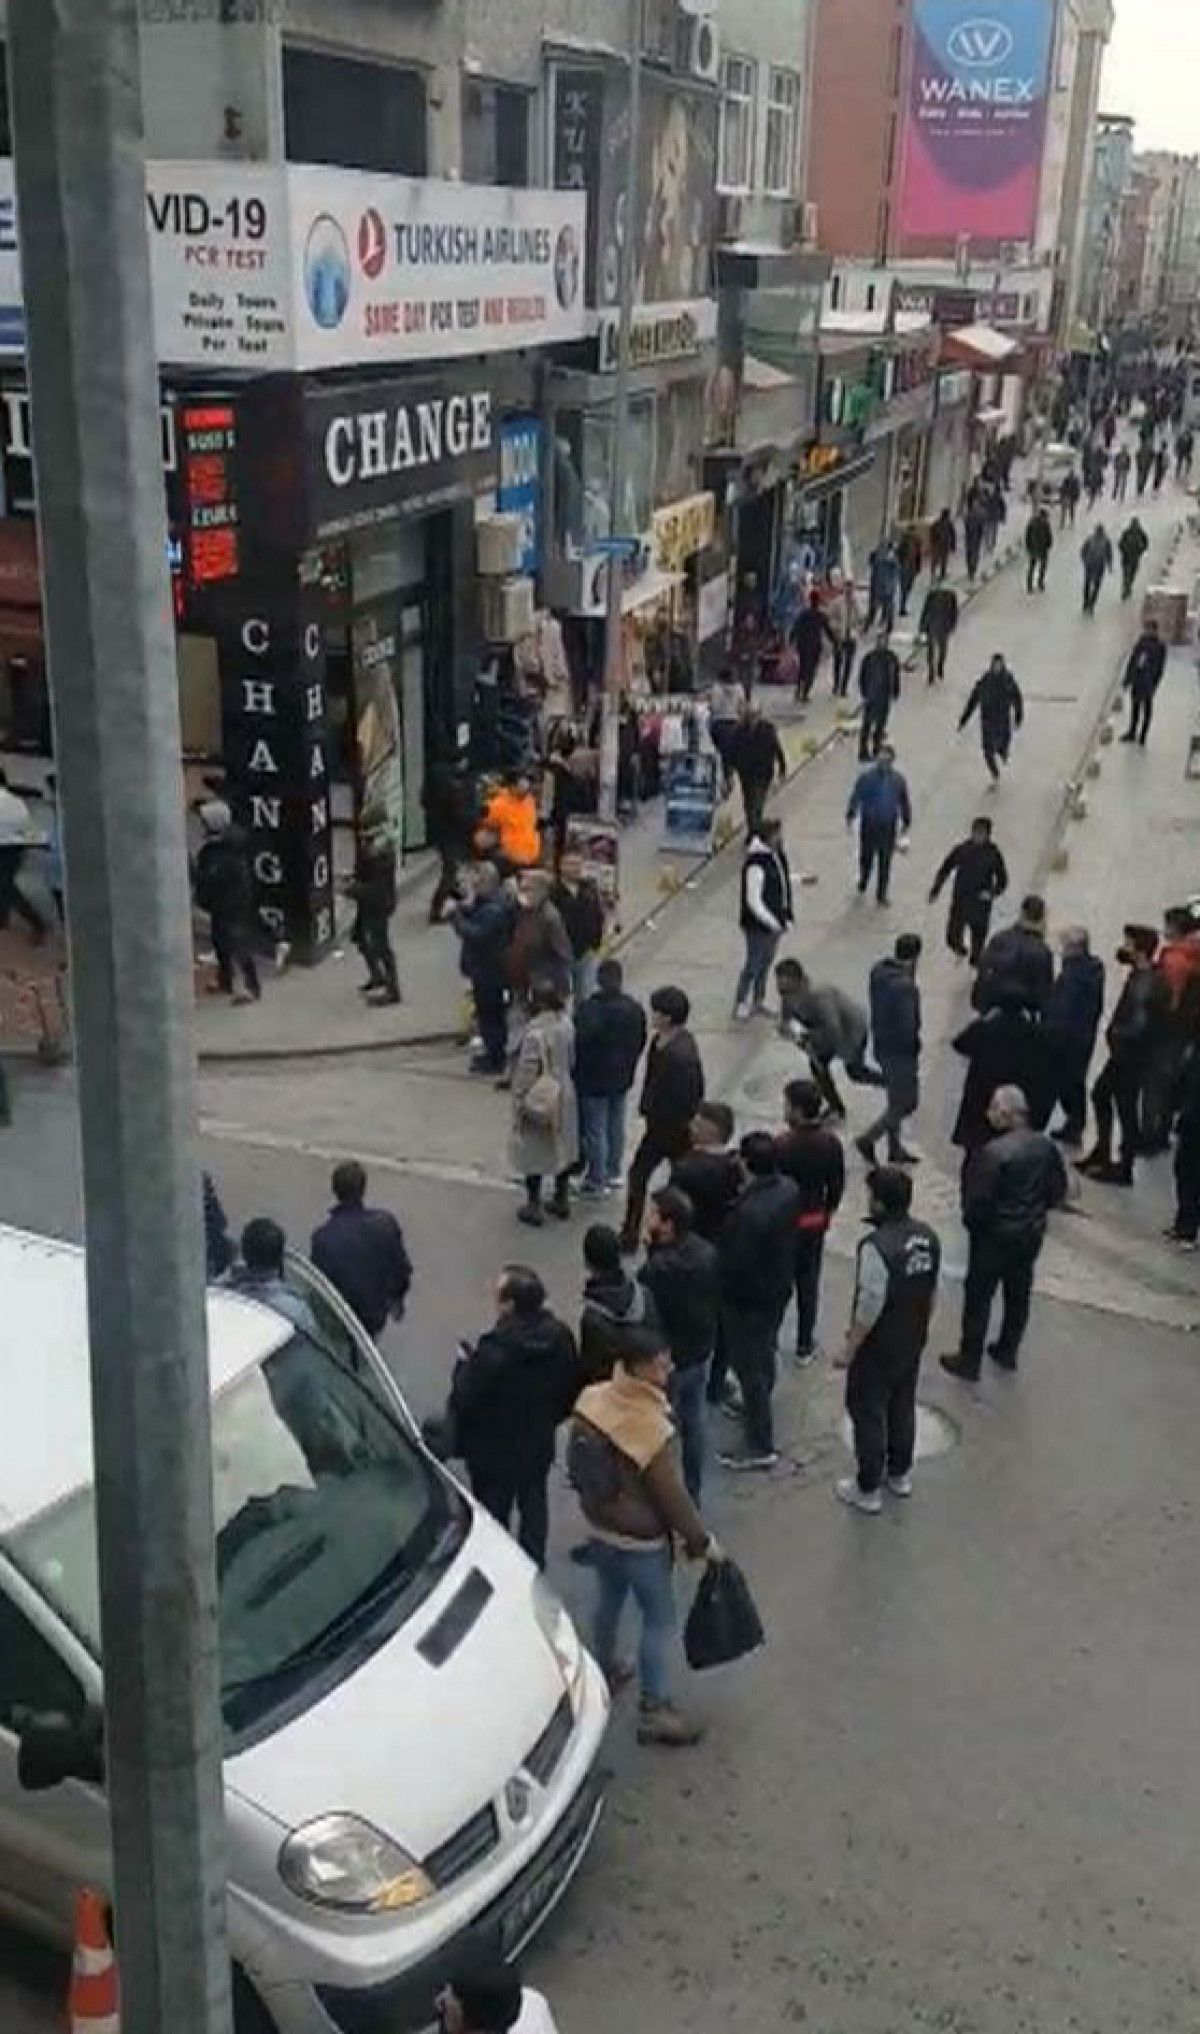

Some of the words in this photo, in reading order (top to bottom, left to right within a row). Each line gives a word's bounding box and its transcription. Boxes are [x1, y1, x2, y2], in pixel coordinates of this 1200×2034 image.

[920, 77, 1033, 102] WANEX
[146, 192, 267, 240] VID-19
[184, 245, 219, 266] PCR
[226, 248, 267, 270] TEST
[394, 223, 478, 265] TURKISH
[481, 226, 551, 265] AIRLINES
[324, 391, 492, 487] CHANGE
[304, 621, 331, 936] CHANGE
